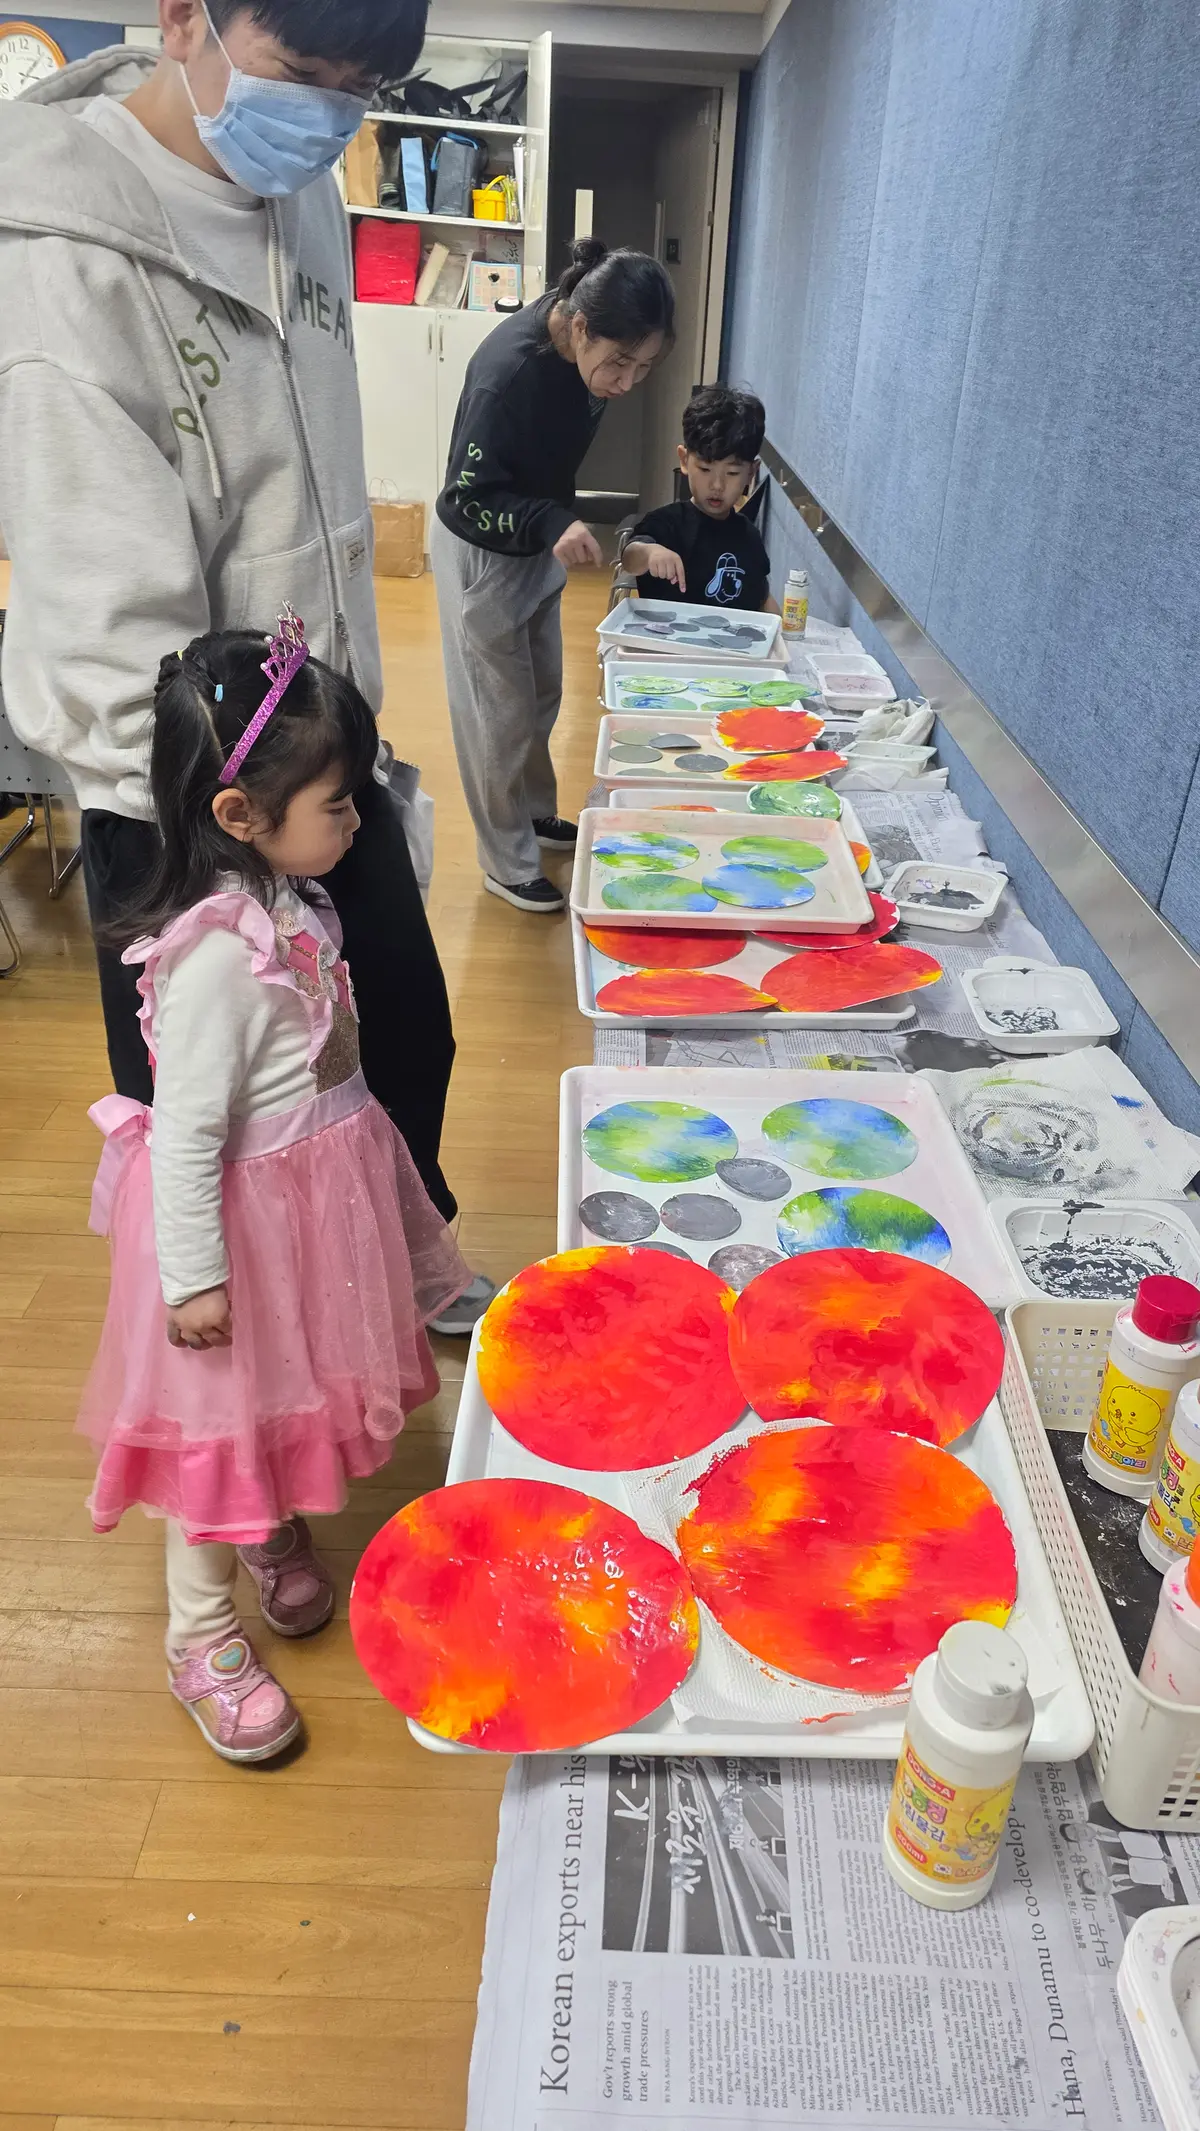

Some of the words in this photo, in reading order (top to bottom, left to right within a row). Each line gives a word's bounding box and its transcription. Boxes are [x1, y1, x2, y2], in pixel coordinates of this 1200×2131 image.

[7, 40, 16, 53] 11
[18, 38, 29, 50] 12
[36, 45, 41, 56] 1
[46, 57, 53, 68] 2
[907, 1750, 953, 1799] DONG-A
[564, 1792, 584, 1848] near
[1002, 1817, 1040, 1916] co-develop
[556, 1856, 586, 1961] exports
[1030, 1922, 1046, 1940] to
[606, 1980, 616, 2017] strong
[622, 1981, 633, 2018] global
[1037, 1947, 1069, 2042] Dunamu
[1110, 1993, 1123, 2026] Thursday
[538, 1970, 574, 2094] Korean
[605, 2021, 615, 2062] reports
[621, 2022, 631, 2053] amid
[640, 2010, 650, 2067] pressures
[1118, 2026, 1127, 2041] said
[1122, 2042, 1133, 2065] Group
[602, 2065, 612, 2098] Gov't
[620, 2057, 632, 2101] growth
[637, 2071, 647, 2102] trade
[1058, 2048, 1086, 2116] Hana,
[1128, 2067, 1142, 2101] Financial
[1111, 2093, 1119, 2110] KIM
[1138, 2102, 1147, 2122] Hana
[1145, 2108, 1157, 2122] had
